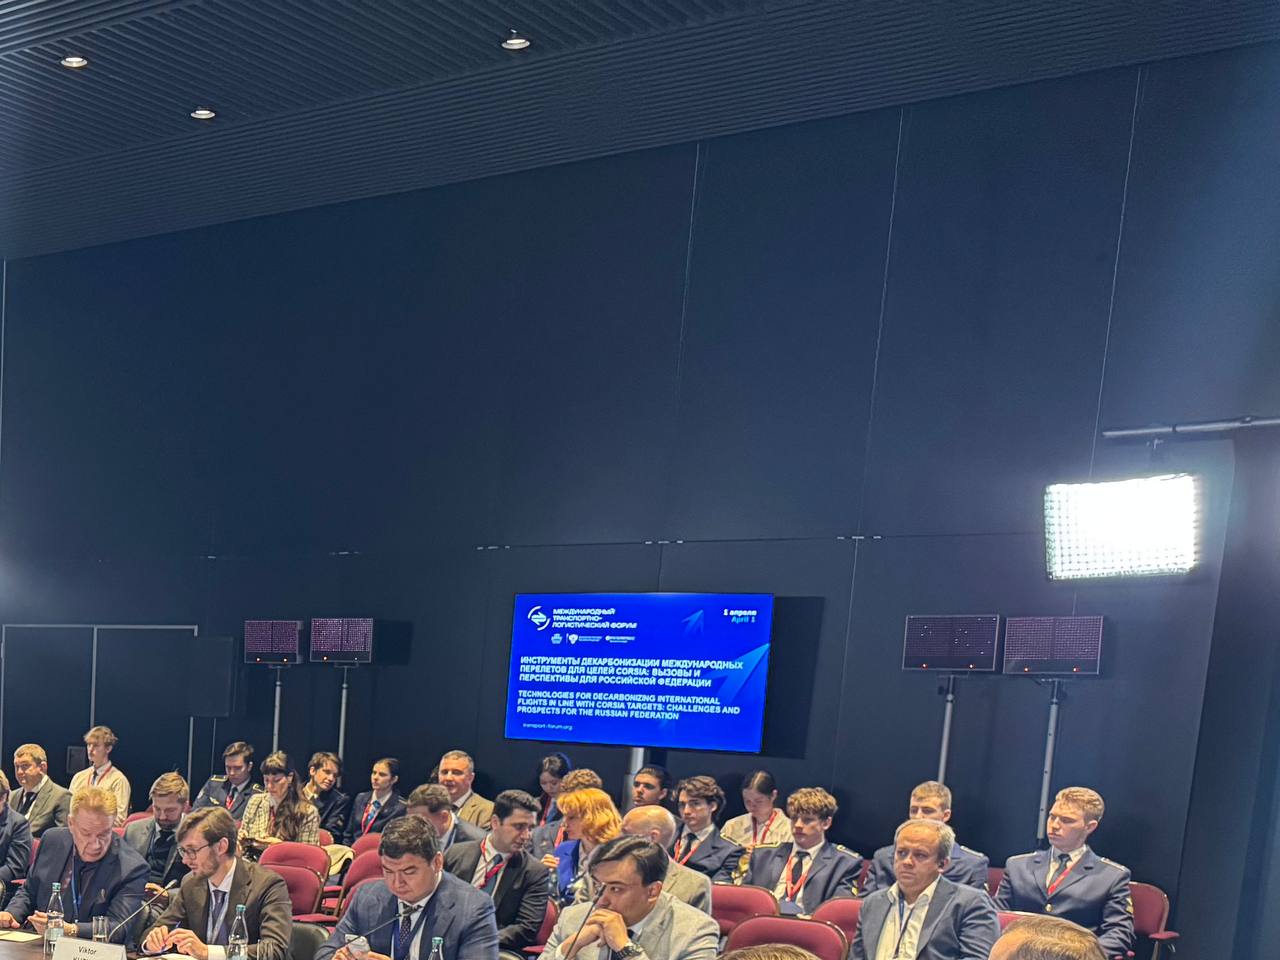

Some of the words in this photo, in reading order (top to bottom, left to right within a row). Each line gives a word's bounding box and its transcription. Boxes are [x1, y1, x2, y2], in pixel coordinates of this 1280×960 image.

[731, 616, 749, 624] April
[520, 656, 581, 665] ИНСТРУМЕНТЫ
[581, 657, 660, 668] ДЕКАРБОНИЗАЦИИ
[661, 659, 744, 669] МЕЖДУНАРОДНЫХ
[520, 665, 567, 674] ПЕРЕЛЕТОВ
[568, 666, 586, 675] ДЛЯ
[586, 666, 615, 675] ЦЕЛЕЙ
[616, 667, 650, 676] CORSIA:
[652, 668, 692, 677] ВЫЗОВЫ
[693, 669, 701, 677] И
[519, 674, 579, 683] ПЕРСПЕКТИВЫ
[579, 675, 597, 684] ДЛЯ
[598, 676, 656, 685] РОССИЙСКОЙ
[657, 678, 712, 688] ФЕДЕРАЦИИ
[518, 690, 575, 699] TECHNOLOGIES
[575, 692, 592, 700] FOR
[592, 692, 656, 702] DECARBONIZING
[657, 695, 721, 705] INTERNATIONAL
[517, 698, 548, 706] FLIGHTS
[548, 699, 557, 707] IN
[558, 699, 575, 708] LINE
[575, 700, 595, 708] WITH
[596, 701, 626, 709] CORSIA
[626, 702, 665, 711] TARGETS:
[666, 704, 721, 713] CHALLENGES
[721, 706, 741, 715] AND
[517, 706, 561, 715] PROSPECTS
[561, 708, 577, 716] FOR
[578, 708, 594, 716] THE
[594, 709, 628, 718] RUSSIAN
[629, 710, 680, 720] FEDERATION
[78, 946, 97, 955] Viktor
